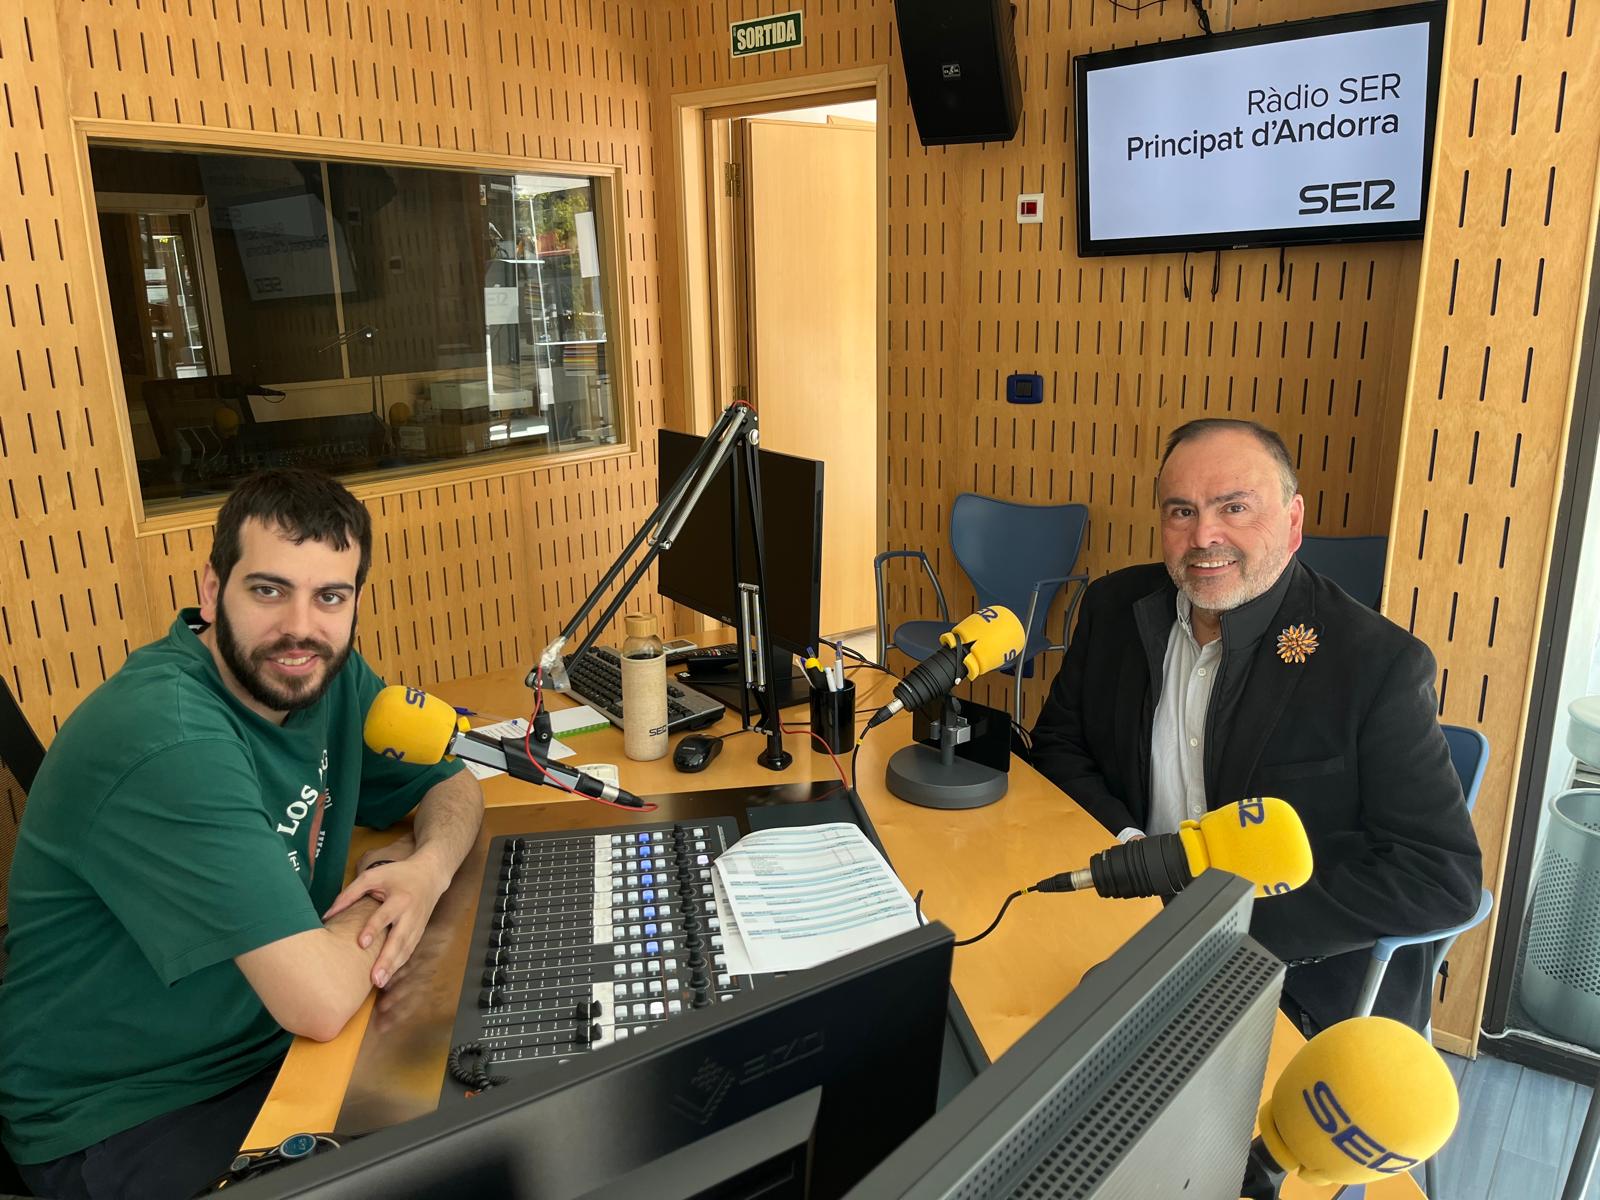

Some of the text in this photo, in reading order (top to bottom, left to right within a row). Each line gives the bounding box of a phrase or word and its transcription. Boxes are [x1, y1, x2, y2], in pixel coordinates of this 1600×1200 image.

[736, 19, 797, 51] SORTIDA
[1248, 73, 1401, 115] Ràdio SER
[1127, 113, 1399, 161] Principat d'Andorra
[1298, 179, 1396, 215] SER
